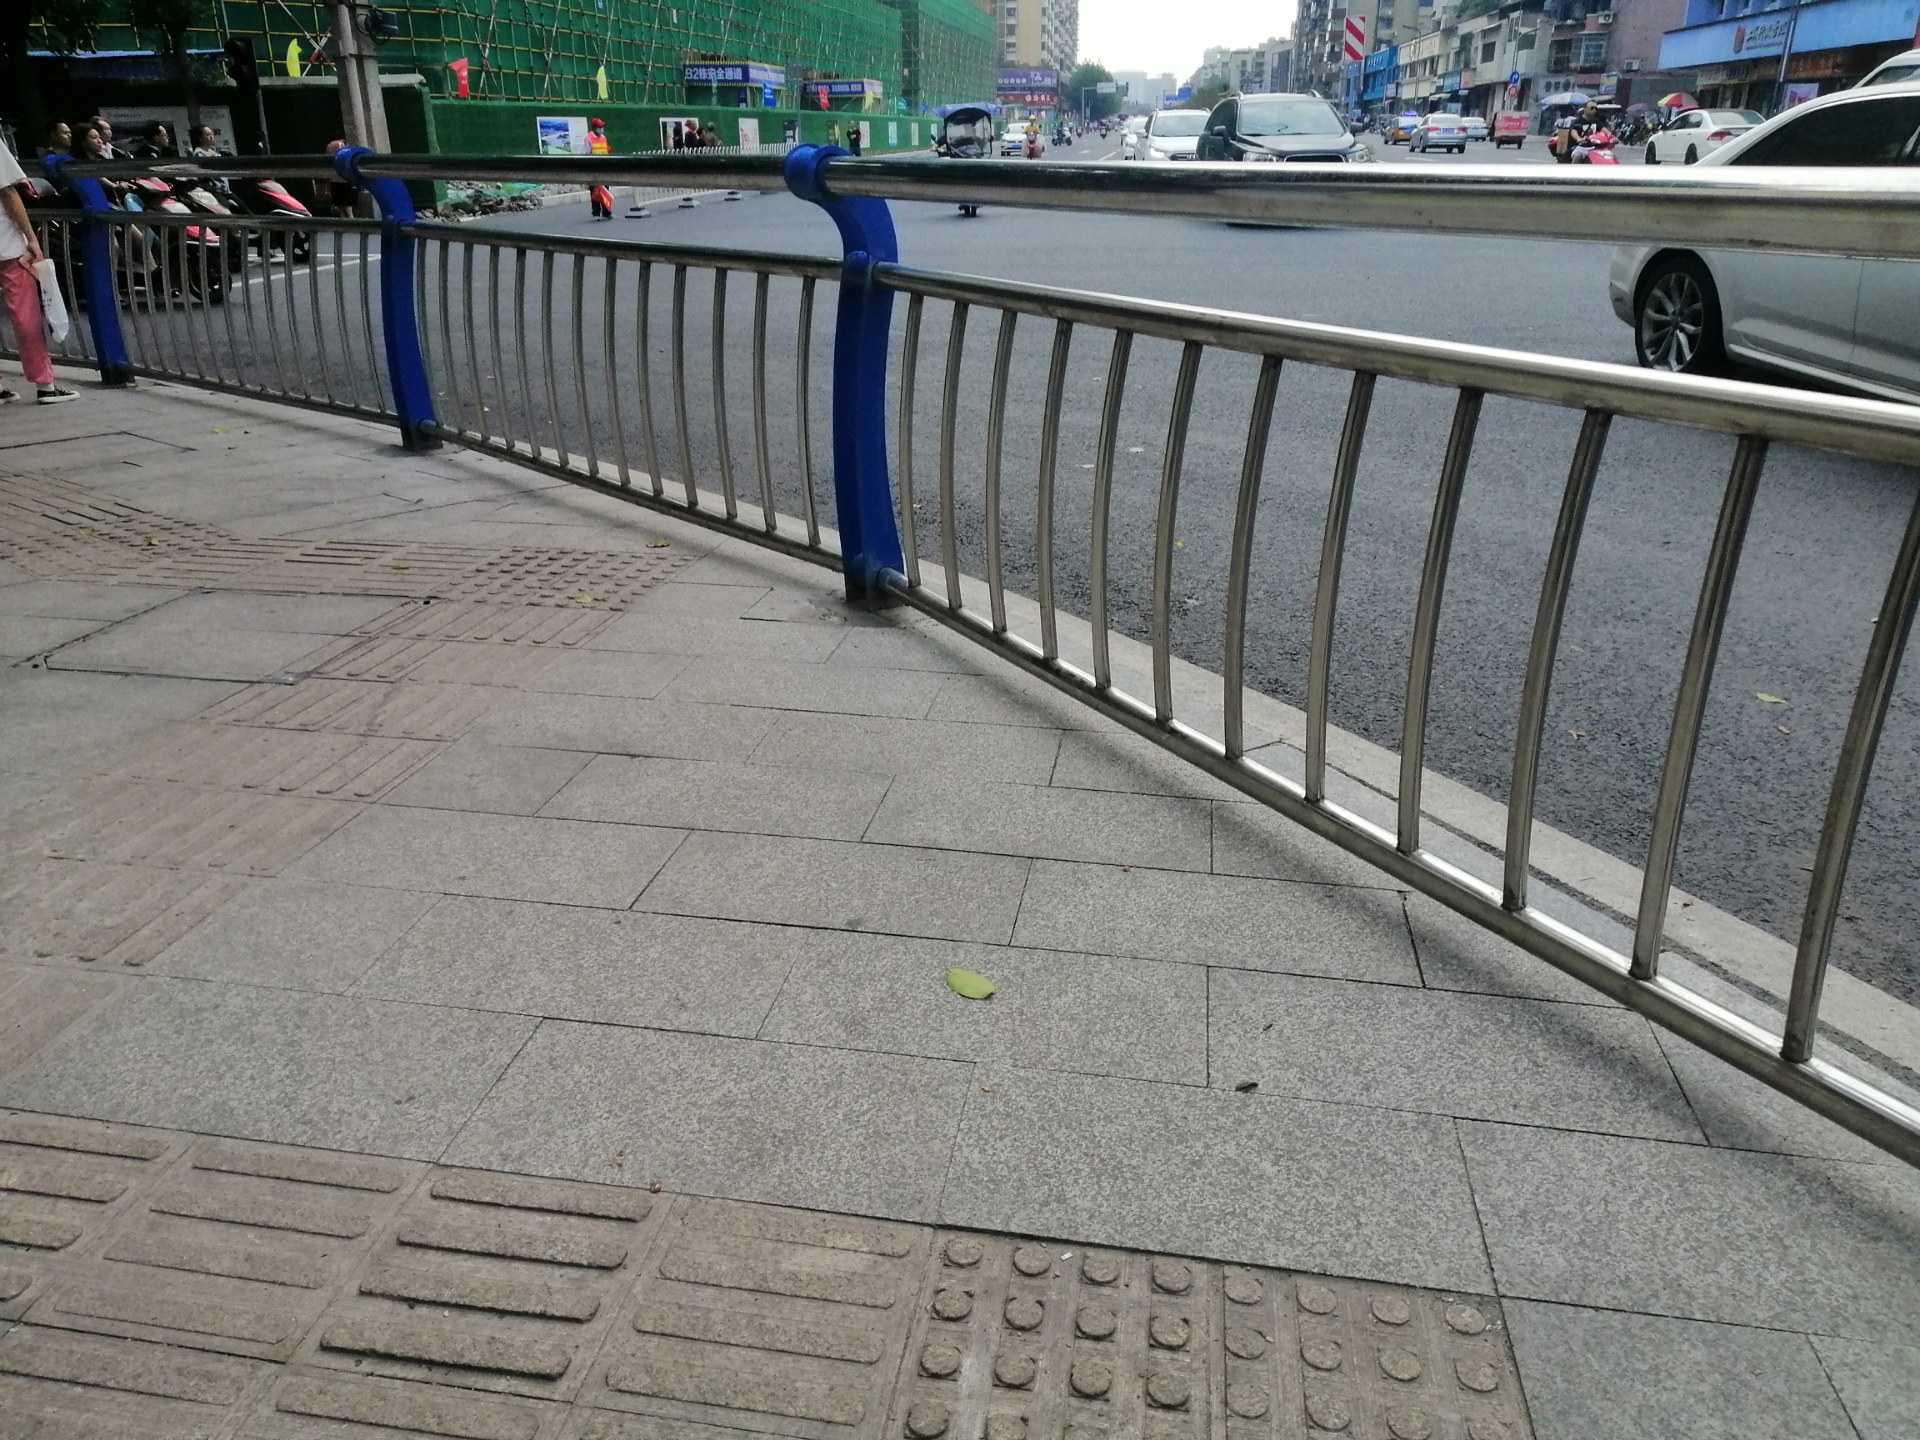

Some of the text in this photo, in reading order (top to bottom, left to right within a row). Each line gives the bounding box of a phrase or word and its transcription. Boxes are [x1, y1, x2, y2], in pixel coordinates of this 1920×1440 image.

[686, 67, 743, 80] B2栋安全通道
